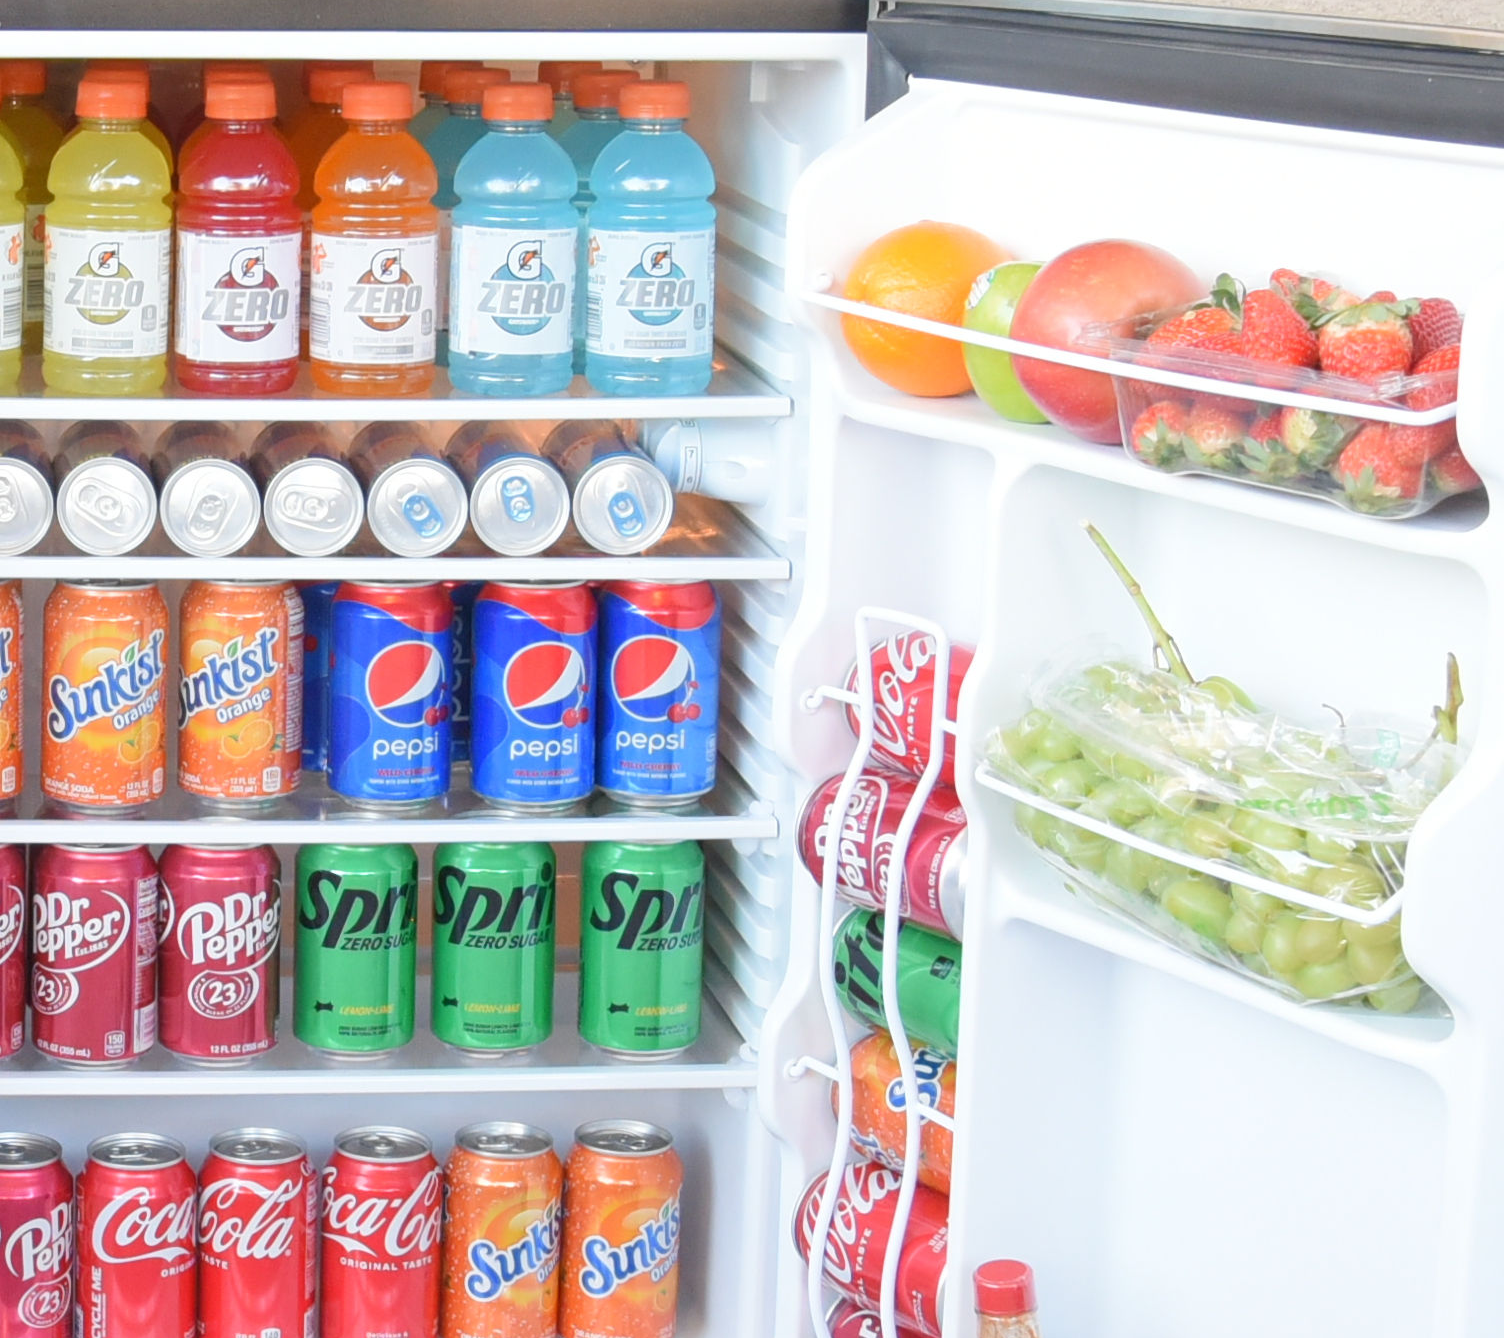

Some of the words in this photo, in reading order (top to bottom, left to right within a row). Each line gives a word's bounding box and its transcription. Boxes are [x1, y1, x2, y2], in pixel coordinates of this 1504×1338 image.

[64, 278, 145, 308] ZERO
[201, 288, 290, 322] ZERO
[344, 285, 423, 315] ZERO
[477, 281, 567, 317] ZERO
[615, 279, 695, 309] ZERO
[48, 629, 164, 741] Sunkist
[113, 689, 160, 730] Orange
[216, 688, 272, 724] Orange
[906, 695, 918, 739] TASTE
[373, 731, 440, 761] pepsi
[510, 733, 579, 762] pepsi
[615, 729, 686, 754] pepsi
[46, 892, 90, 931] Dr
[223, 891, 267, 933] Dr
[299, 861, 418, 950] Spri
[434, 862, 555, 946] Spri
[340, 936, 386, 951] ZERO
[464, 934, 507, 950] ZERO
[637, 937, 677, 952] ZERO
[37, 975, 56, 1002] 23
[208, 980, 238, 1006] 23
[107, 1033, 124, 1045] 150
[210, 1044, 219, 1054] 12
[220, 1044, 230, 1054] FL
[231, 1044, 242, 1054] OZ
[339, 1257, 399, 1272] ORIGINAL
[402, 1255, 433, 1271] TASTE
[856, 1226, 873, 1275] TASTE
[91, 1266, 103, 1291] ME
[38, 1290, 61, 1316] 23
